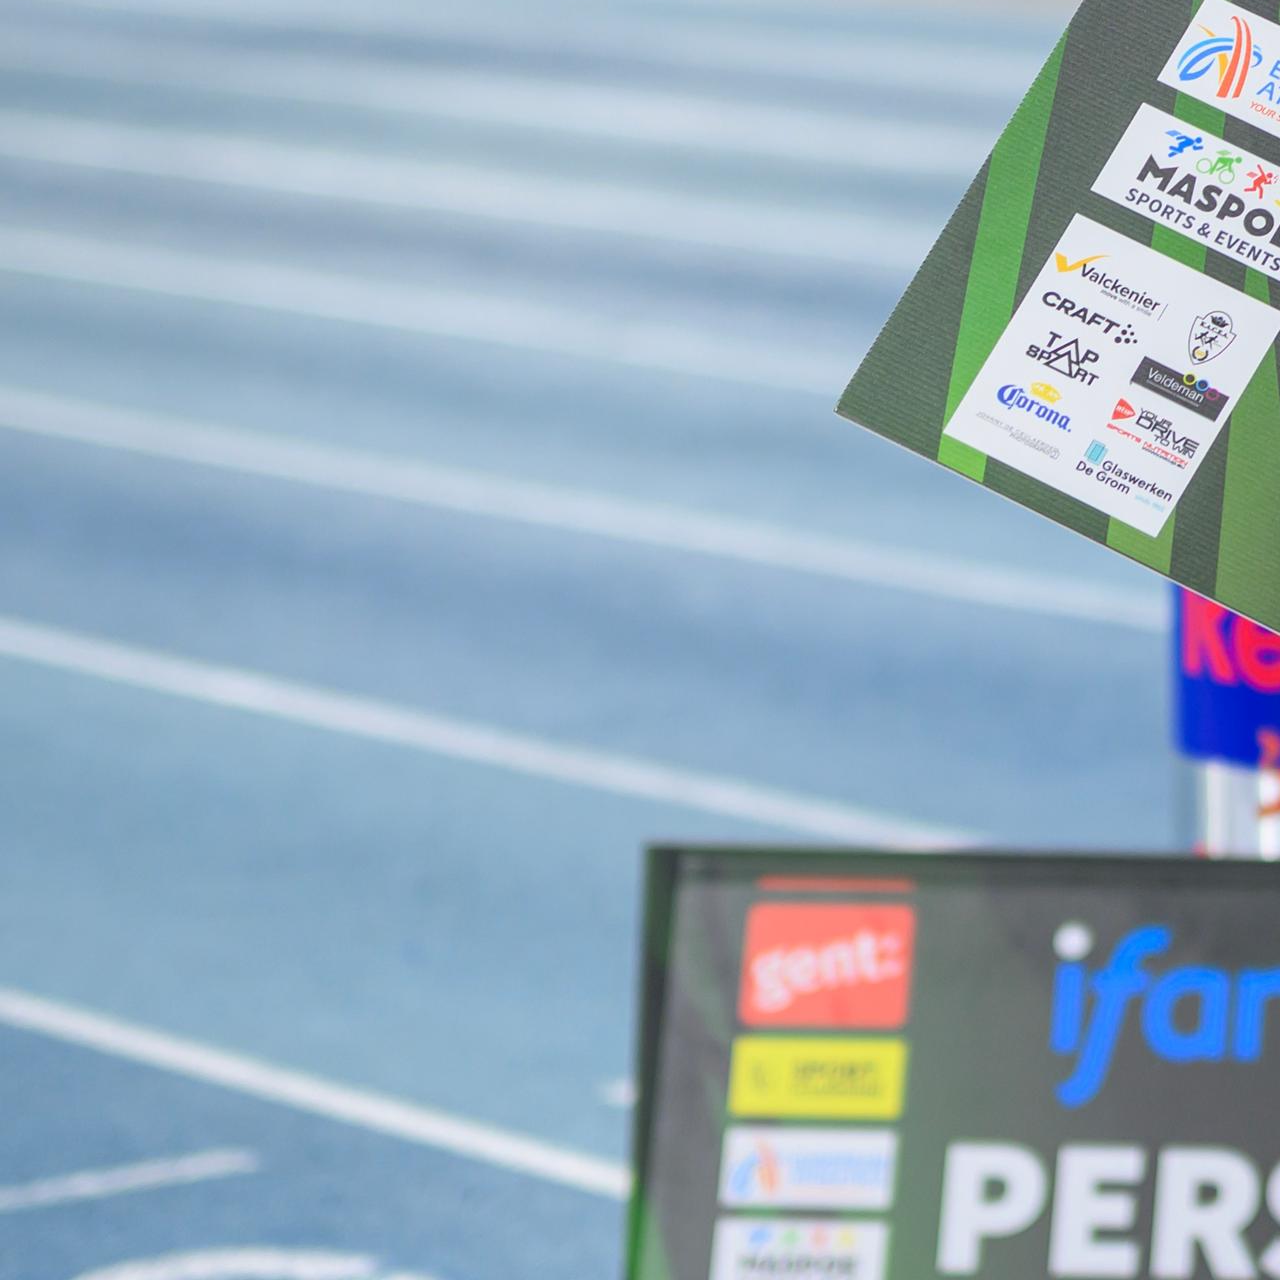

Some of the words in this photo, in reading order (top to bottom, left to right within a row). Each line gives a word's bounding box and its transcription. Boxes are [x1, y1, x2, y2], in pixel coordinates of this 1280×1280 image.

[1250, 101, 1276, 118] YOUR
[1125, 188, 1196, 229] SPORTS
[1197, 223, 1211, 238] &
[1081, 263, 1160, 311] Valckenier
[1042, 292, 1120, 334] CRAFT
[1147, 367, 1206, 405] Veldeman
[1135, 414, 1201, 451] DRIVE
[1140, 410, 1172, 429] YOUR
[1154, 434, 1170, 447] TO
[1172, 442, 1196, 460] WIN
[1076, 460, 1093, 476] De
[1096, 471, 1130, 494] Grom
[1102, 460, 1172, 501] Glaswerken
